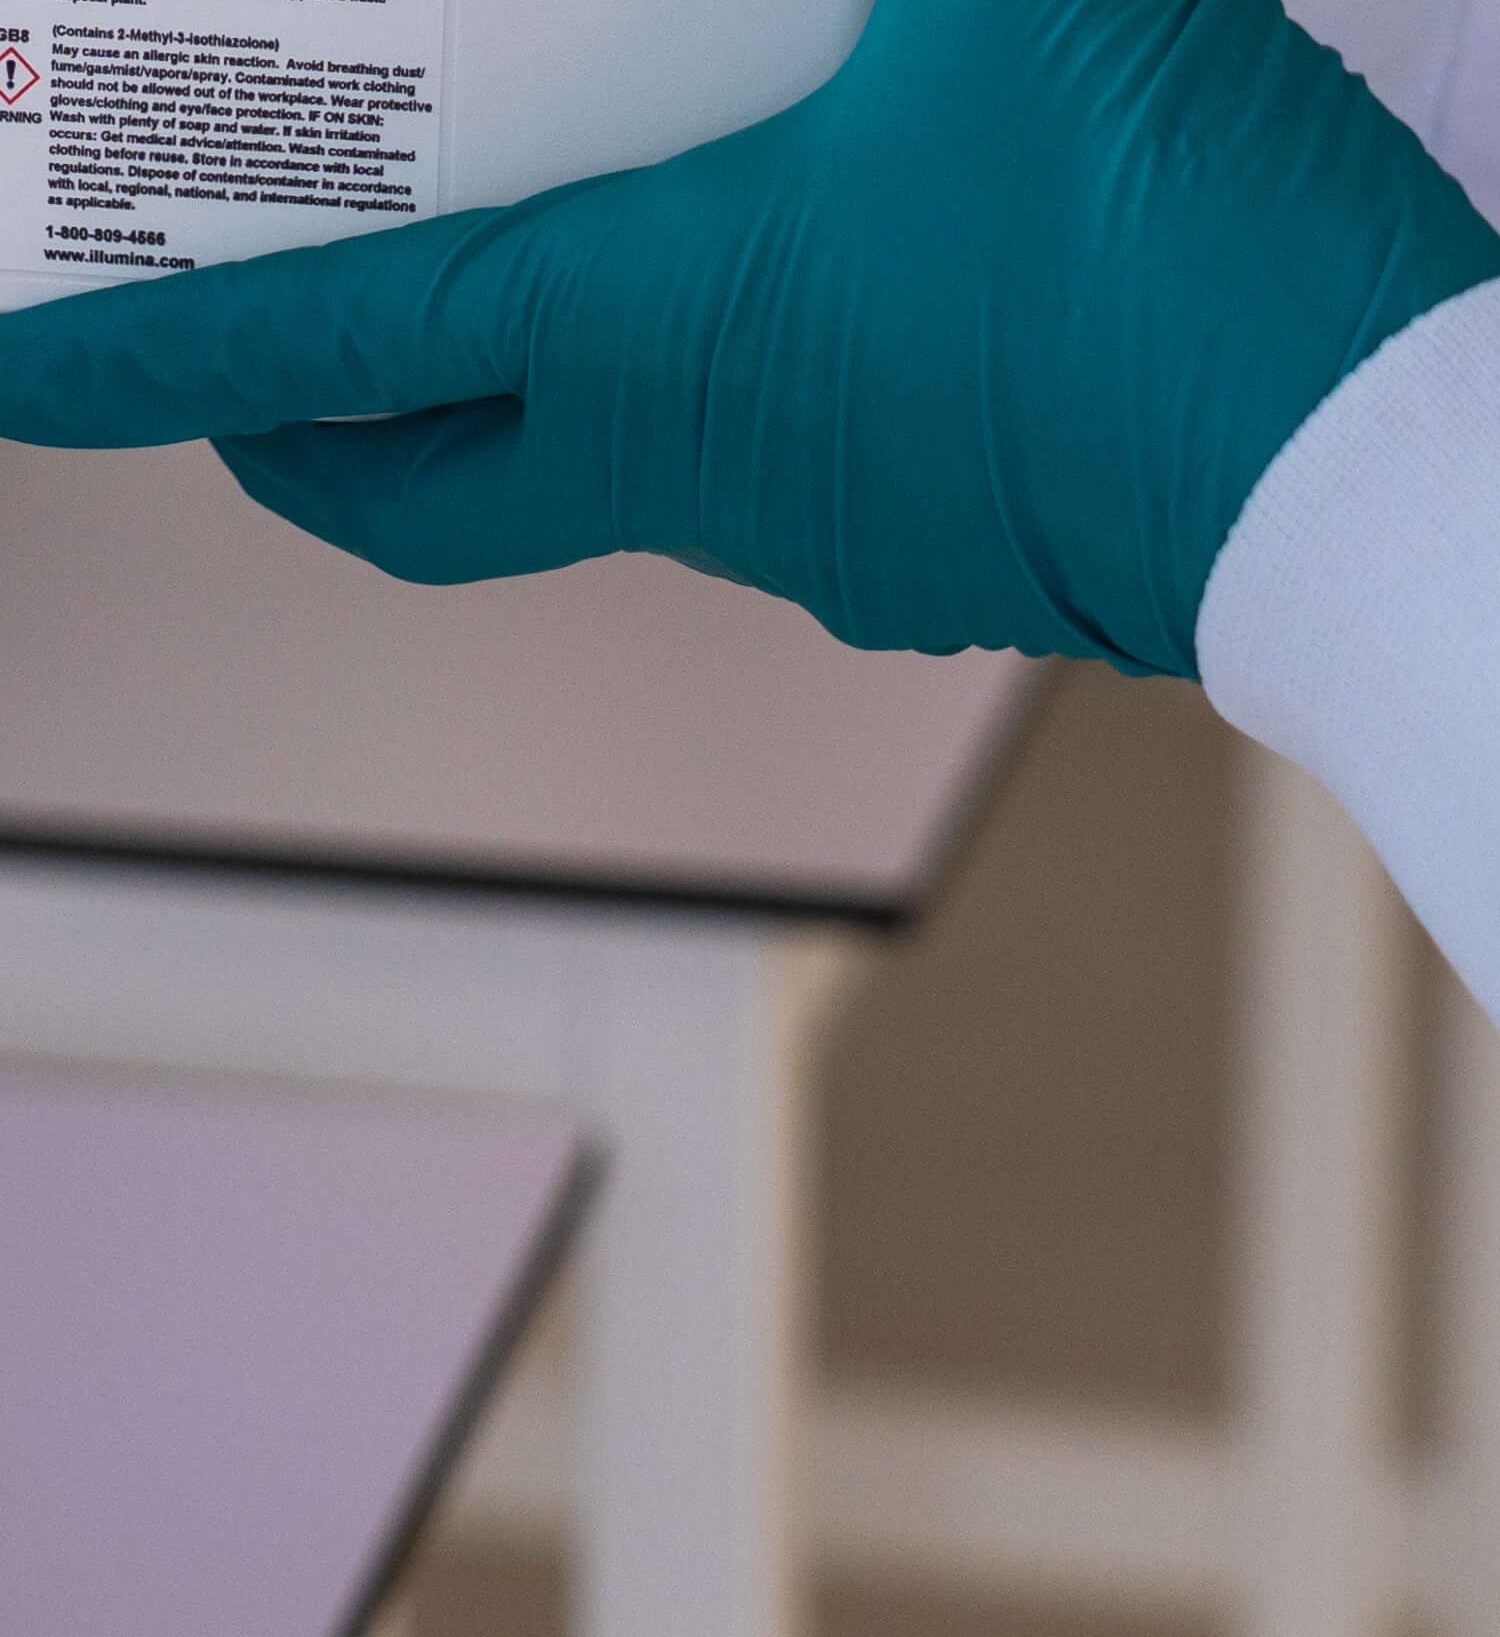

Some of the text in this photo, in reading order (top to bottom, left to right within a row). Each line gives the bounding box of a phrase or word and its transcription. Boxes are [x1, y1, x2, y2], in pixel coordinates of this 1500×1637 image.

[51, 23, 115, 40] (Contains
[50, 58, 416, 97] fume/gas/mist/vapors/spray. Contaminated work clothing
[51, 42, 426, 79] May cause an allergic skin reaction. Avoid breathing dust/
[49, 75, 432, 113] should not be allowed out of the workplace. Wear protective
[49, 92, 384, 127] gloves/clothing and eye/face protection. IF ON SKIN:
[48, 109, 381, 143] Wash with plenty of soap and water. If skin irritation
[48, 142, 384, 177] clothing before reuse. Store in accordance with local
[47, 195, 136, 210] as applicable.
[43, 248, 195, 269] www.illumina.com
